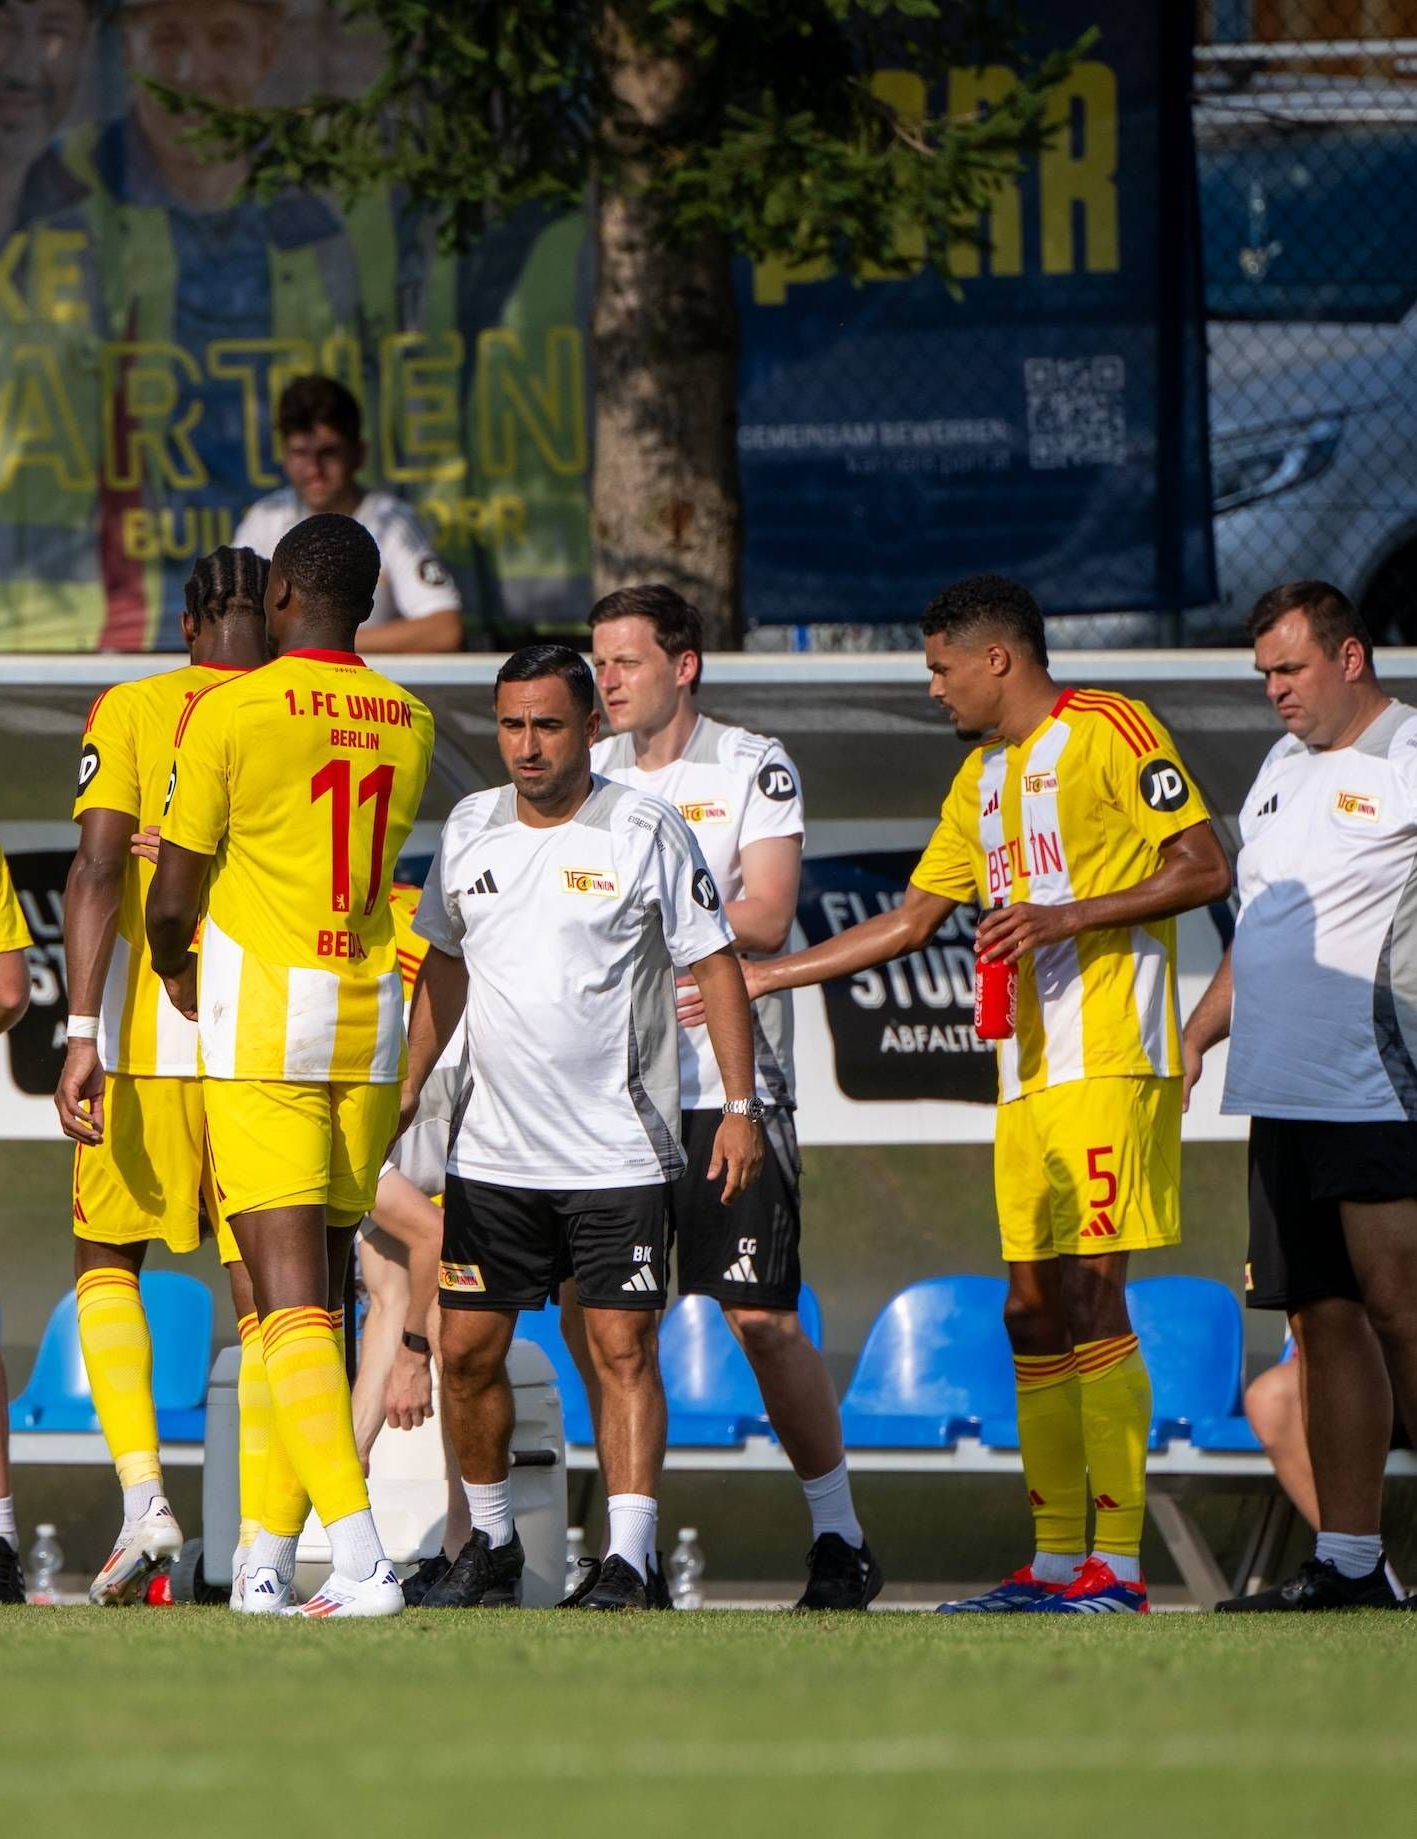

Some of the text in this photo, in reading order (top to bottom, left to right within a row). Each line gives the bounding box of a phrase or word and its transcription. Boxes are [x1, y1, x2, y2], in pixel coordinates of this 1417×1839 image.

[285, 689, 413, 729] 1. FC UNION
[330, 728, 380, 751] BERLIN
[765, 770, 794, 796] JD
[1150, 767, 1183, 807] JD
[311, 759, 396, 916] 11
[627, 815, 654, 832] EISERN
[849, 945, 978, 1009] STUD
[1087, 1145, 1117, 1209] 5
[632, 1245, 653, 1262] BK
[738, 1237, 757, 1255] CG
